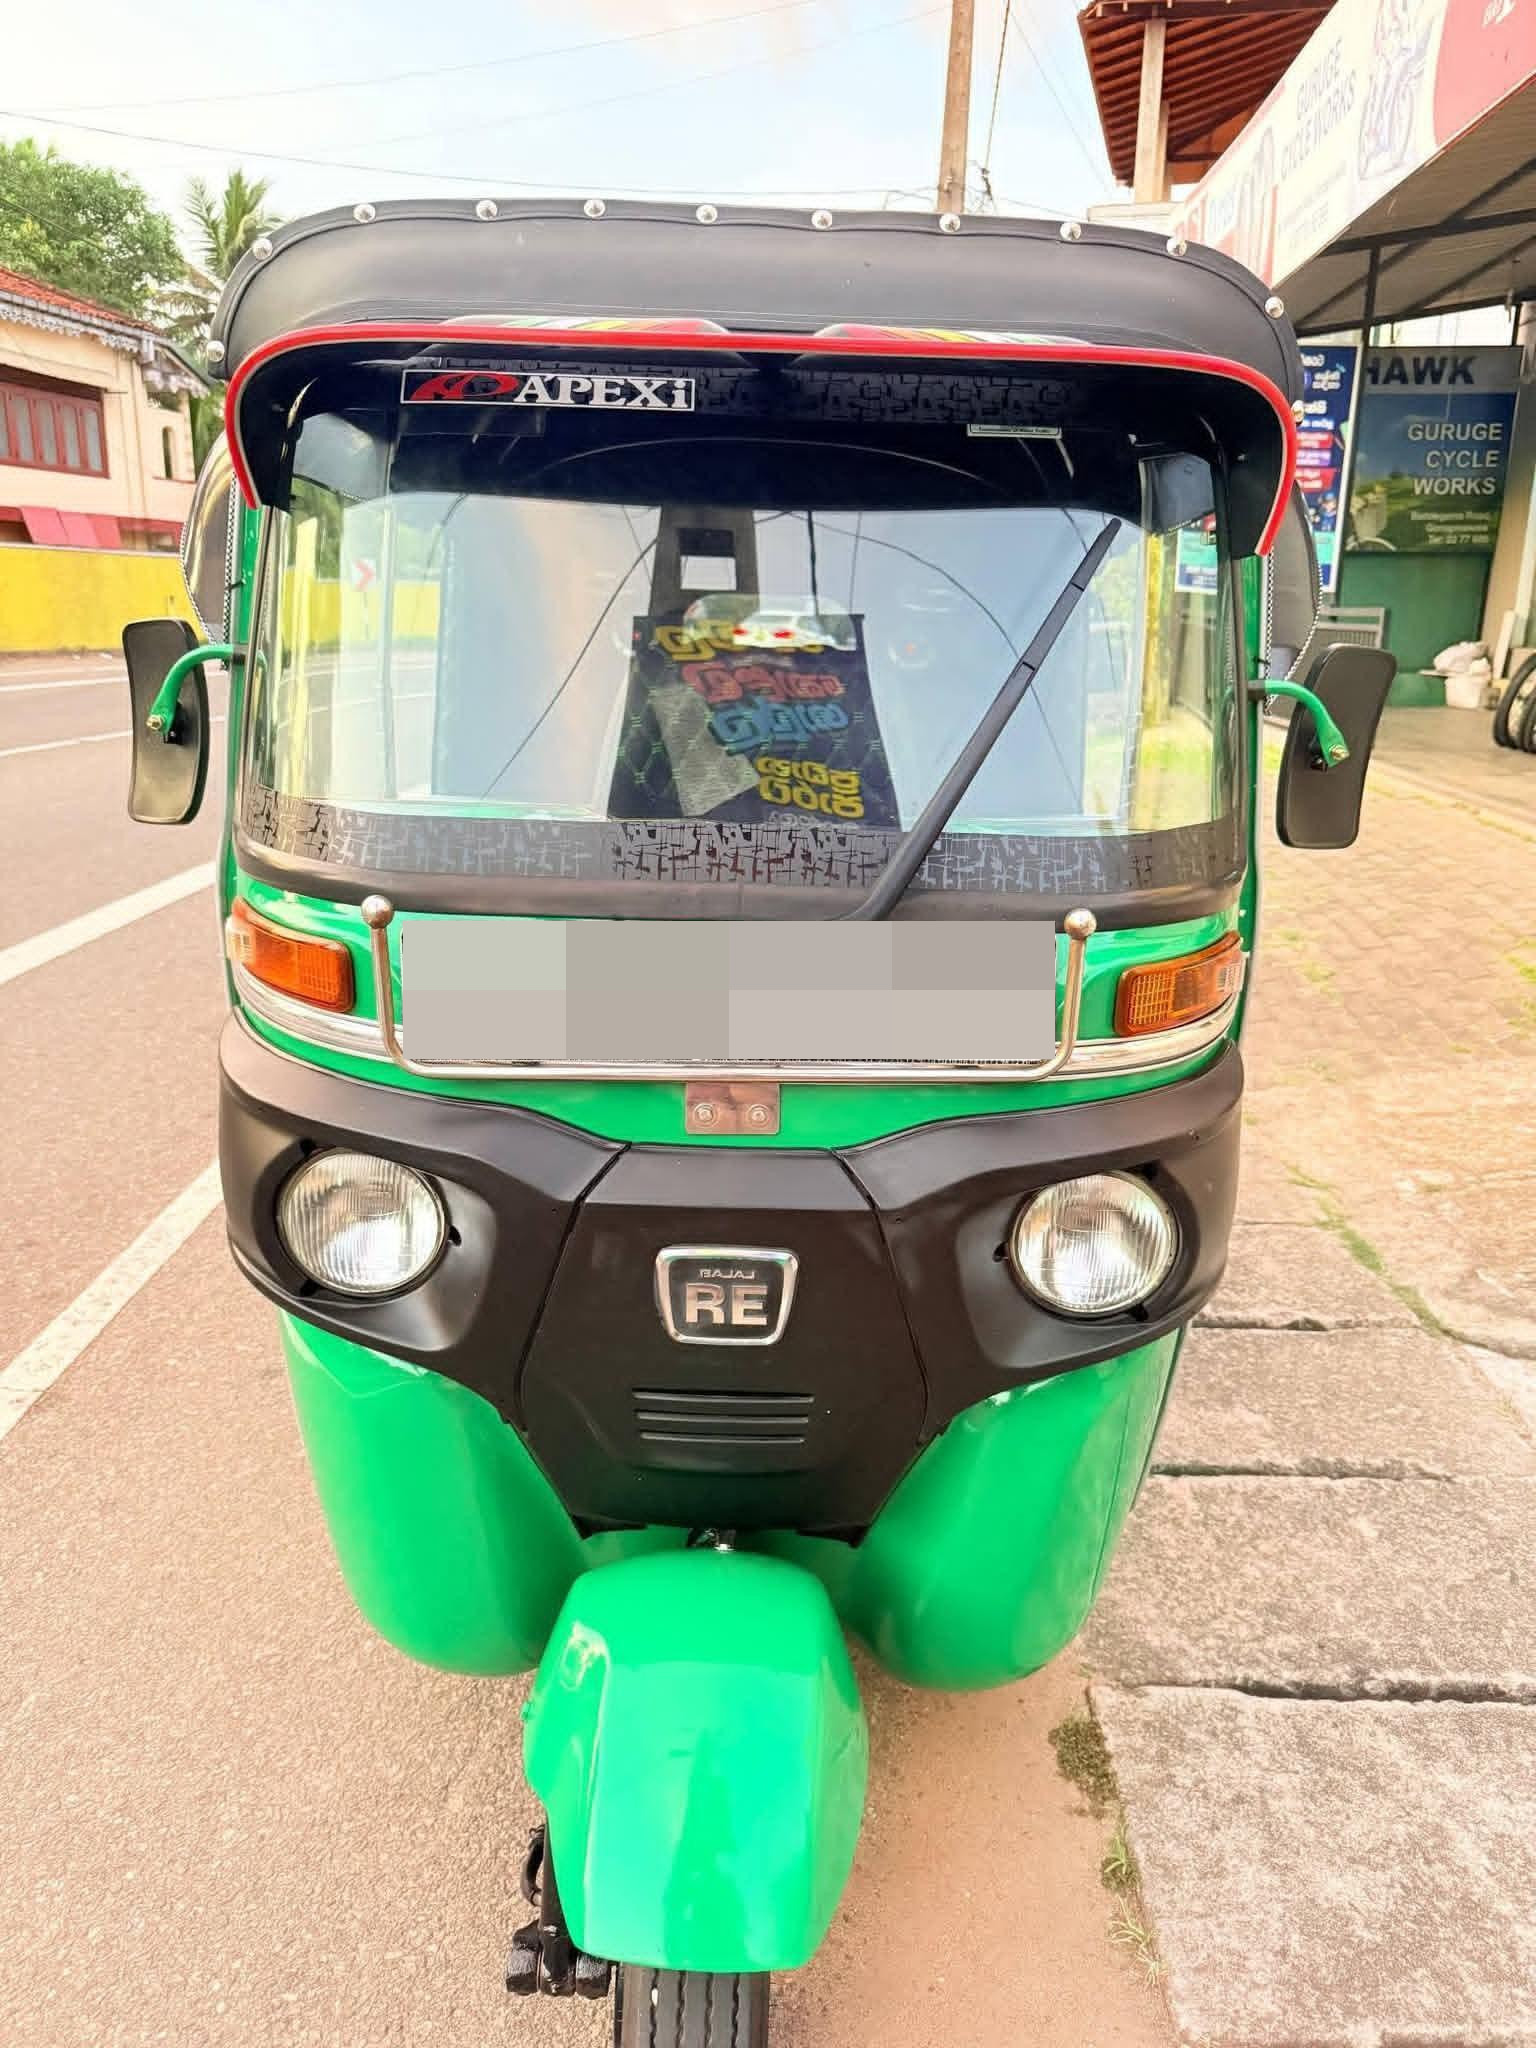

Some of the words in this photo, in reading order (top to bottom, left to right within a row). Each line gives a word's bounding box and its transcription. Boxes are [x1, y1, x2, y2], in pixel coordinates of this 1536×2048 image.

[1408, 423, 1503, 441] GURUGE
[1426, 450, 1499, 468] CYCLE
[1414, 477, 1496, 495] WORKS
[701, 1268, 755, 1280] BAJAJ
[686, 1283, 767, 1326] RE
